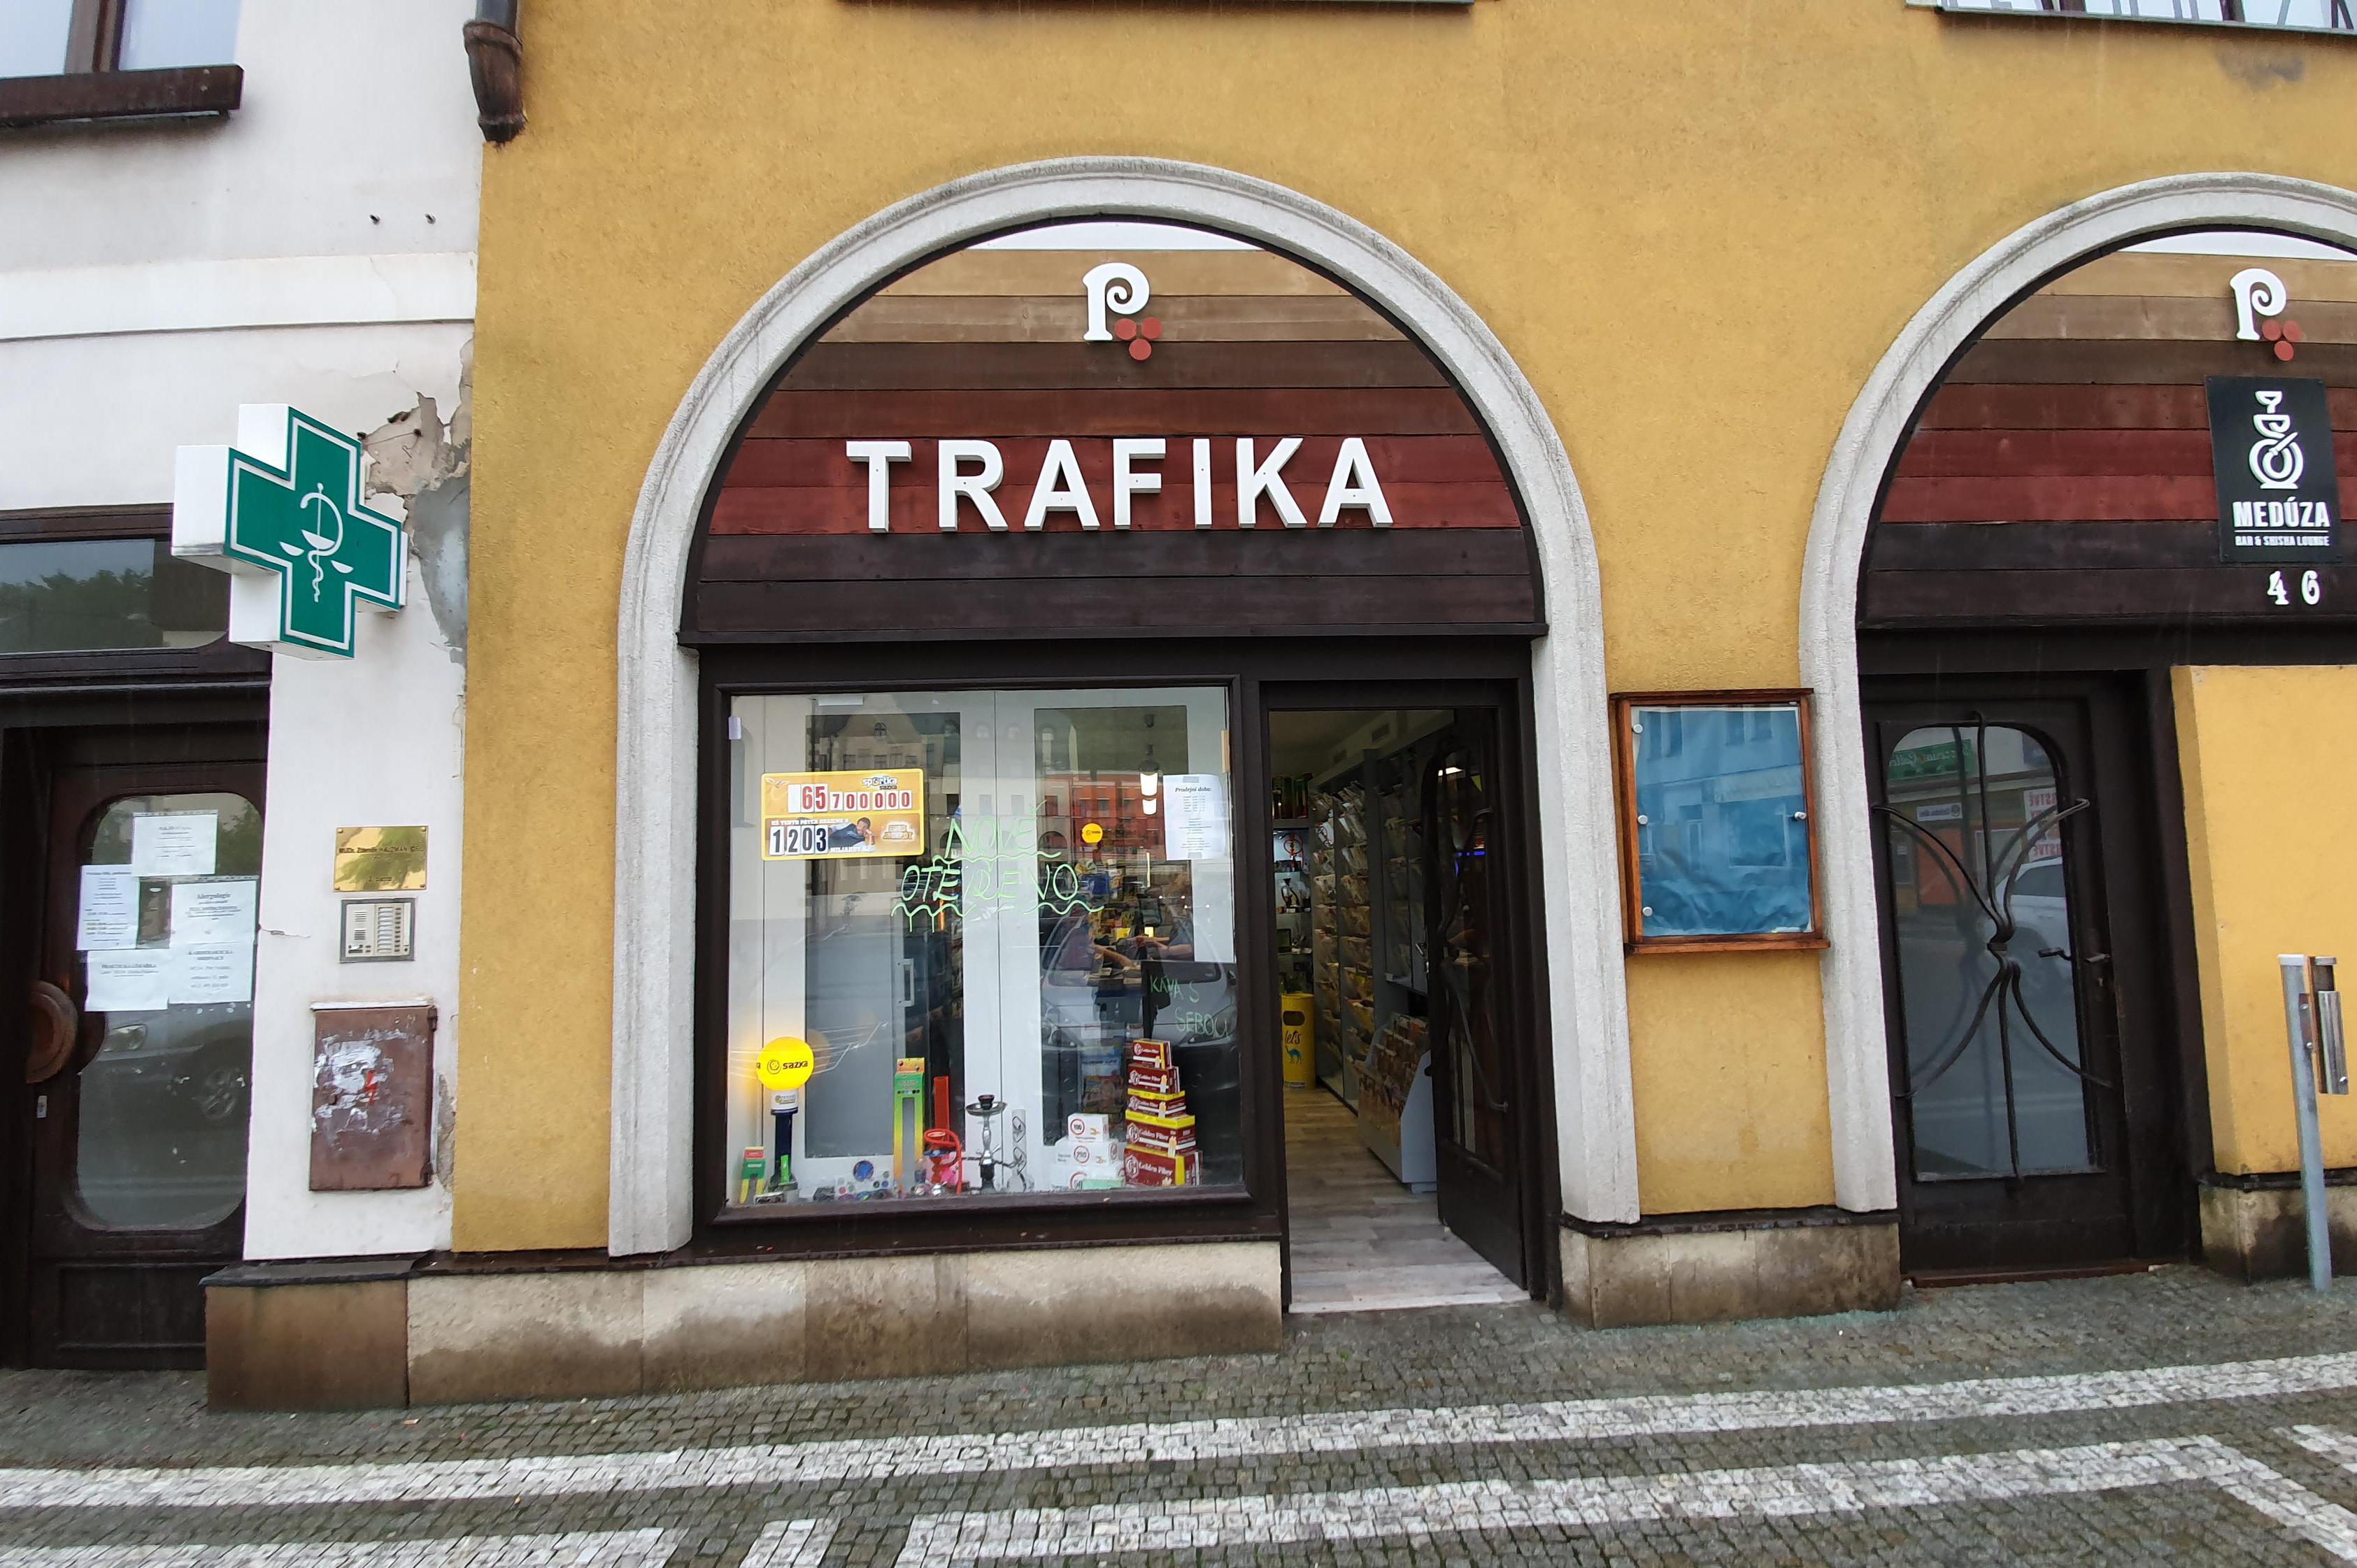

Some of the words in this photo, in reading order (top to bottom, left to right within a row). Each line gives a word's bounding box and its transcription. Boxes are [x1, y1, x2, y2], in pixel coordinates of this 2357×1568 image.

[846, 437, 1394, 534] TRAFIKA
[2232, 496, 2330, 527] MEDÚZA
[2235, 536, 2253, 546] BAR
[2263, 536, 2295, 546] SHISHA
[2296, 536, 2330, 546] LOUNGE
[783, 1061, 808, 1069] sazka
